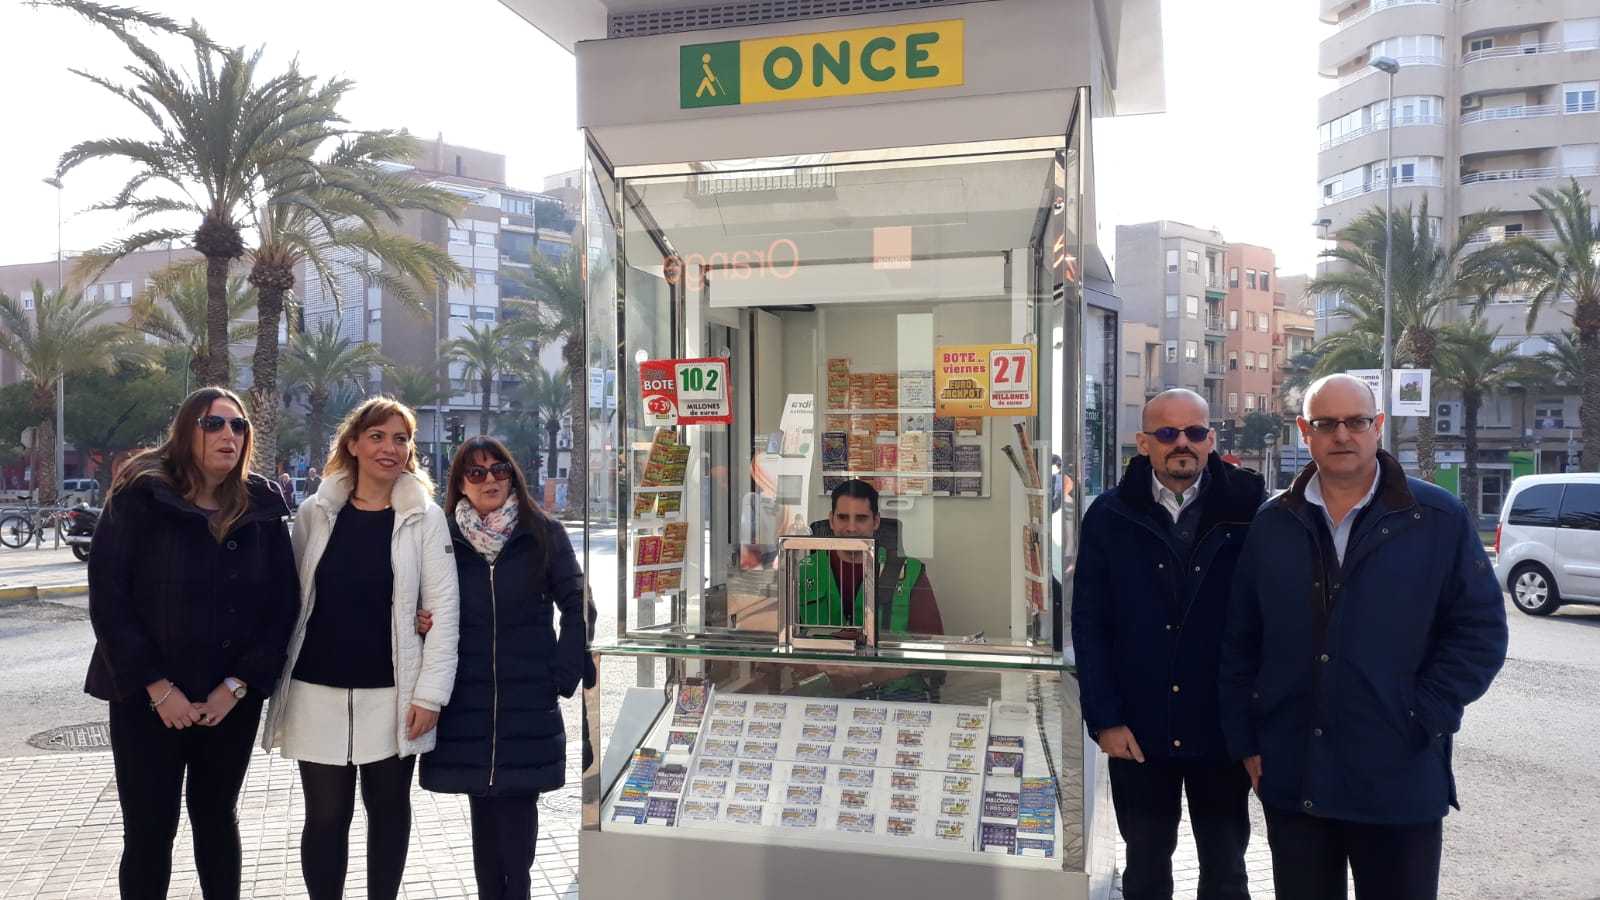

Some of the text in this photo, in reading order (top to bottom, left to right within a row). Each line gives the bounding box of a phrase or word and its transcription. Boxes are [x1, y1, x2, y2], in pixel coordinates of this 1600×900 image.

[763, 32, 939, 90] ONCE
[943, 352, 976, 363] BOTE
[943, 364, 986, 374] viernes
[994, 356, 1026, 384] 27
[643, 380, 674, 390] BOTE
[679, 367, 719, 392] 10,2
[992, 393, 1029, 401] MILLONES
